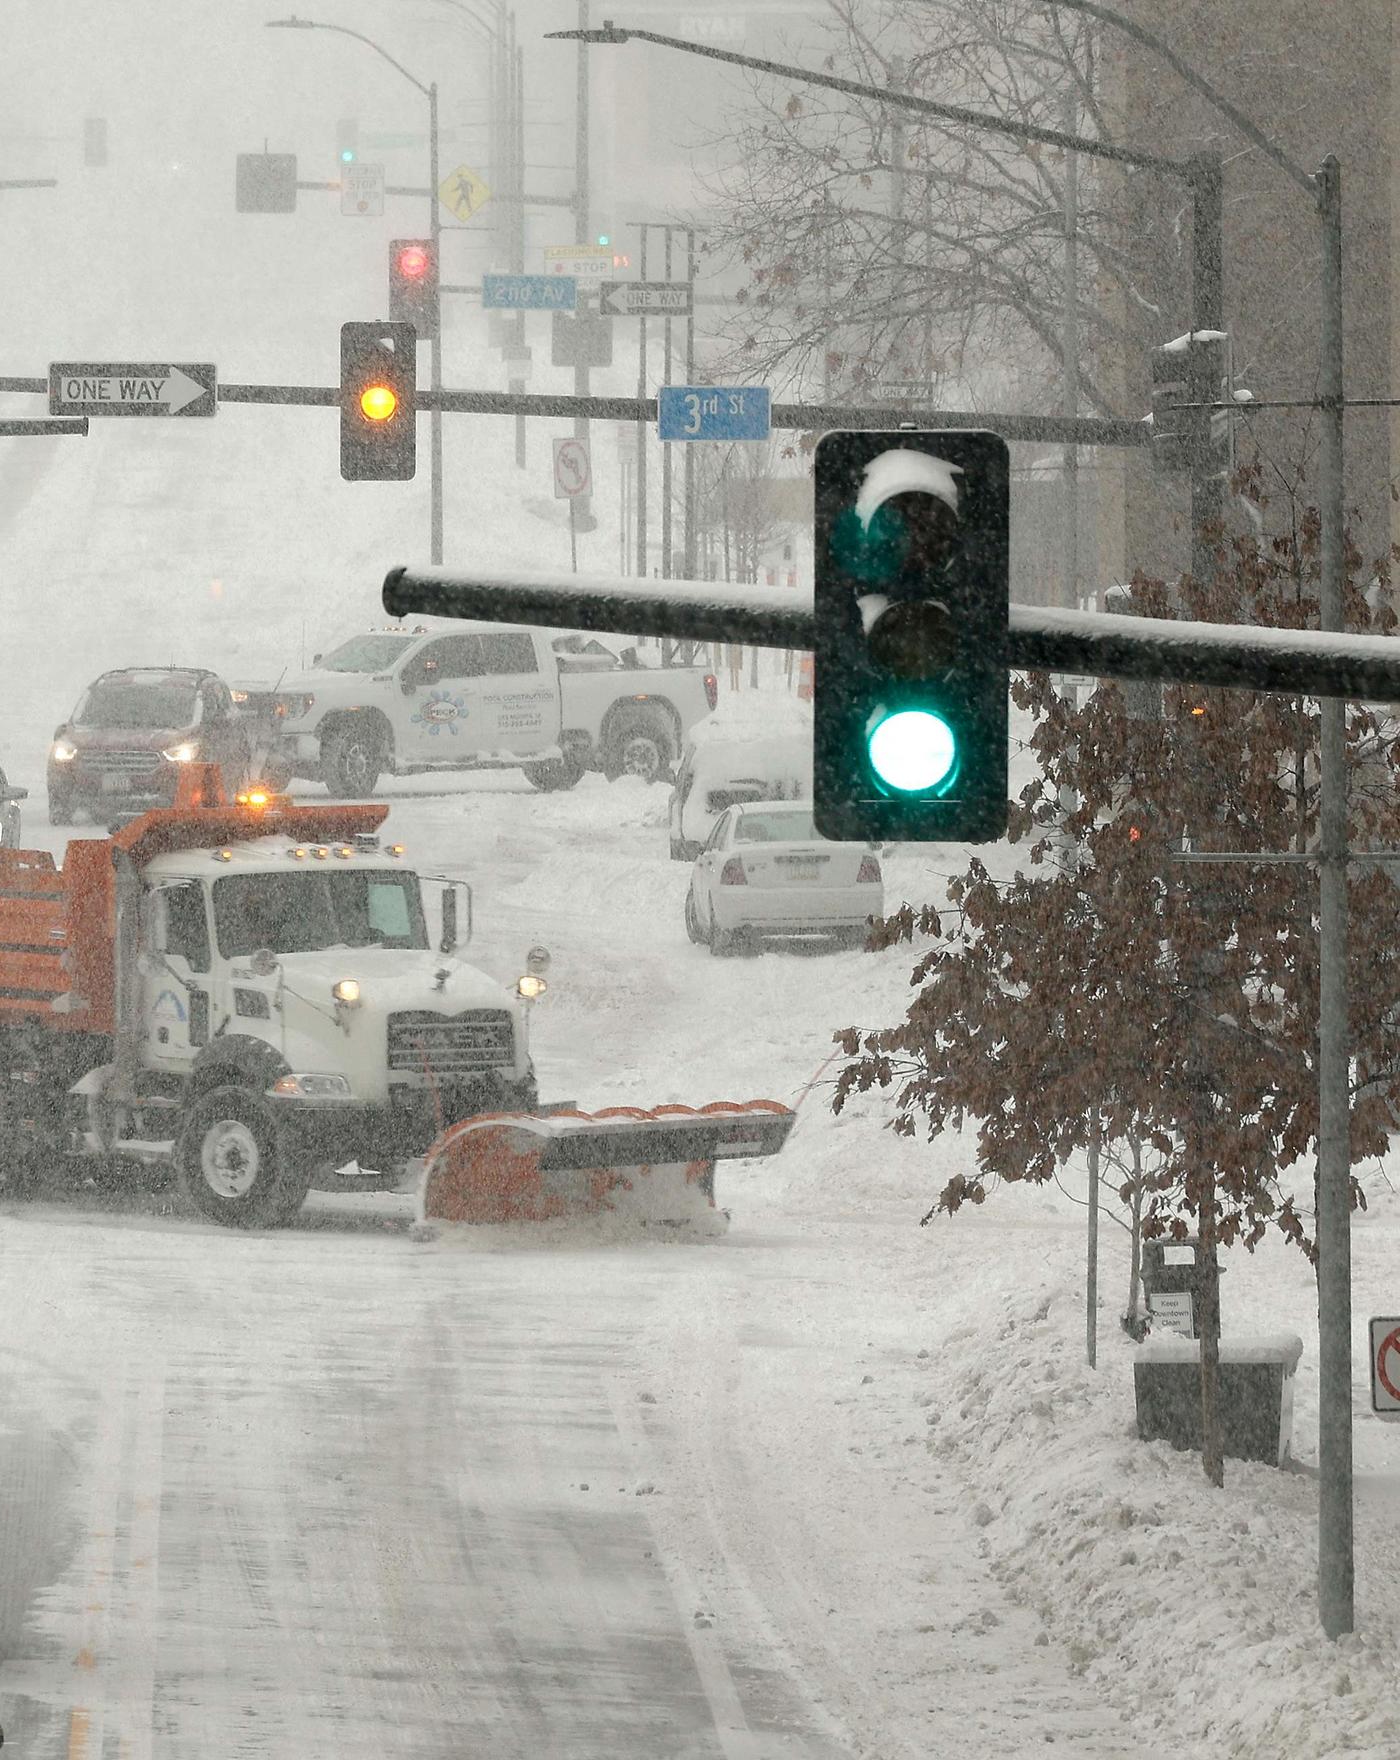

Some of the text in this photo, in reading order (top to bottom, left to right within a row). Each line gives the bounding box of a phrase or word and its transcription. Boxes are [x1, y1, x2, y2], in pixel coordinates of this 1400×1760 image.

[573, 262, 608, 273] STOP
[494, 283, 565, 301] 2nd Av
[626, 290, 683, 306] ONE WAY
[66, 379, 166, 401] ONE WAY
[684, 393, 745, 434] 3rd St
[502, 692, 554, 703] CONSTRUCTION
[431, 707, 457, 717] PECK
[1161, 1300, 1179, 1308] Keep
[1152, 1310, 1189, 1318] Downtown
